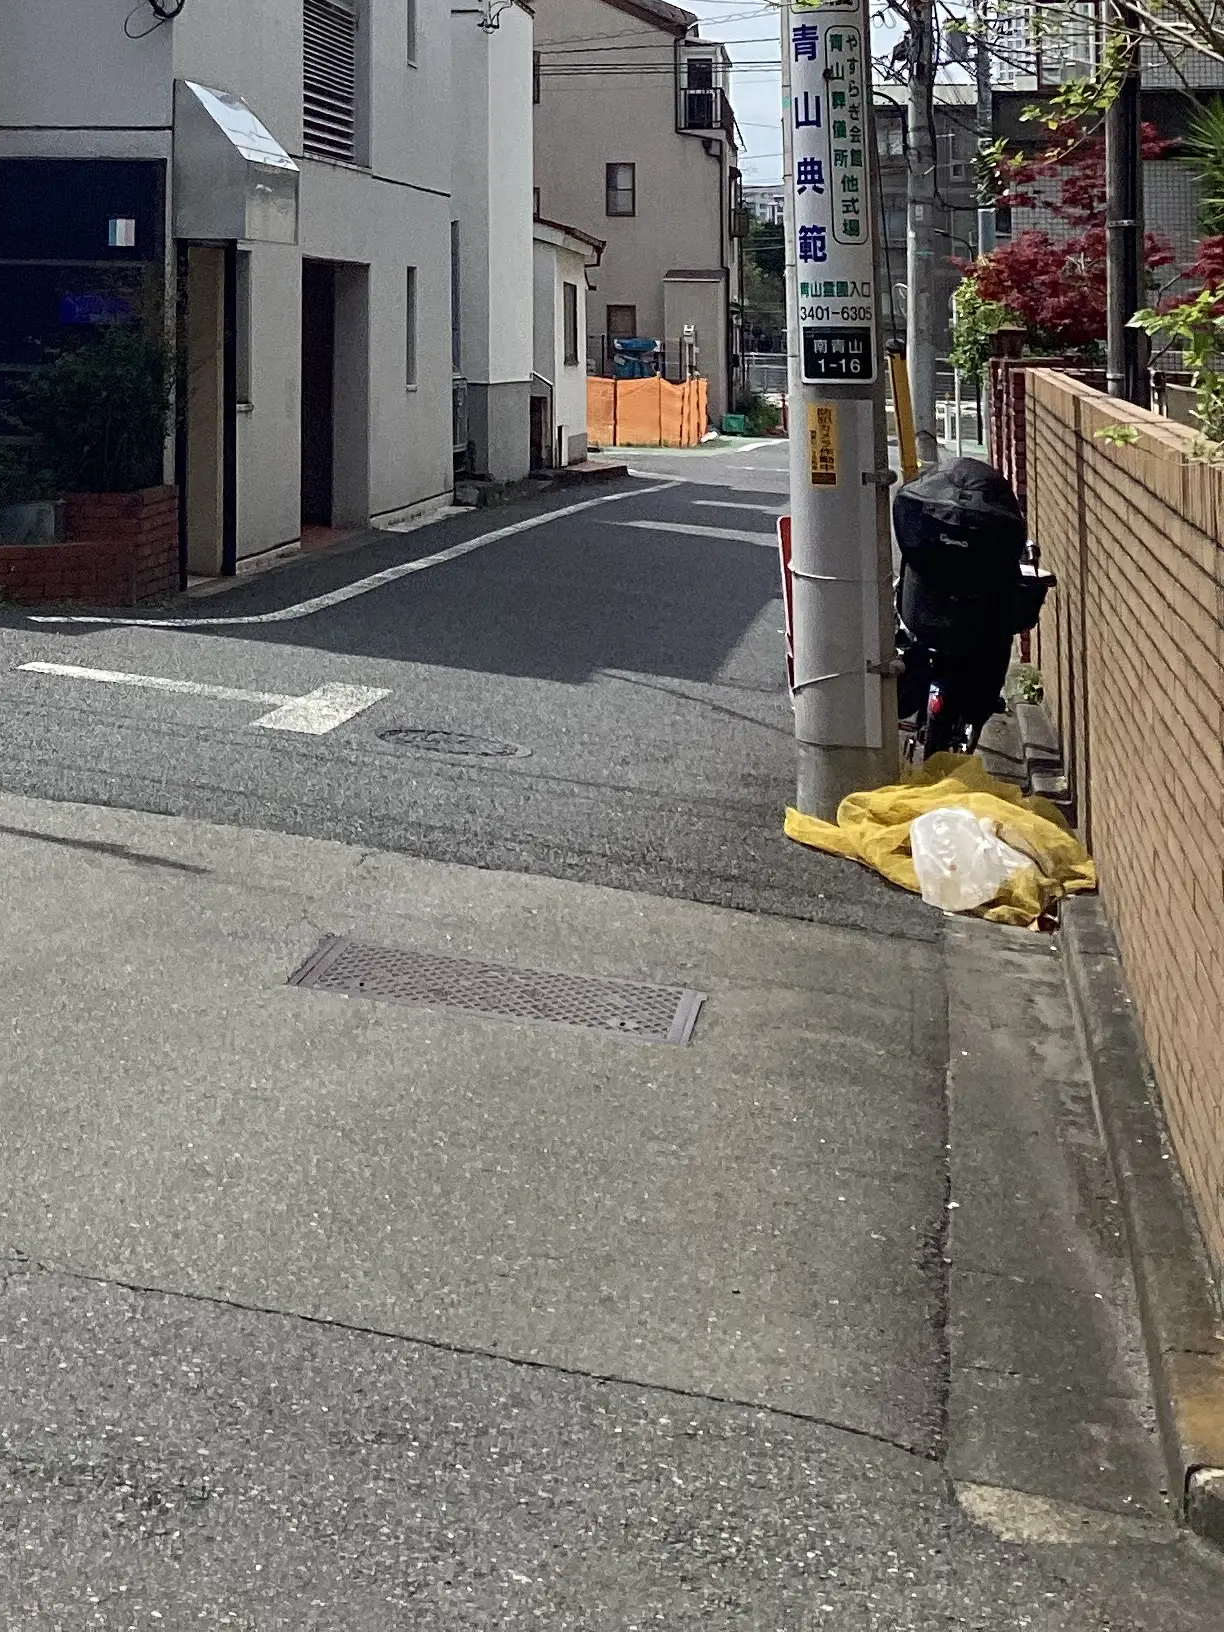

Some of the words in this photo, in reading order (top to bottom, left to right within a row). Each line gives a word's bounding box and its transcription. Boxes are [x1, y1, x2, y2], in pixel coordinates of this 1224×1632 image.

[792, 24, 828, 263] 青山典範
[800, 306, 873, 321] 3401-6305
[813, 339, 863, 354] 南青山
[817, 358, 861, 374] 1-16
